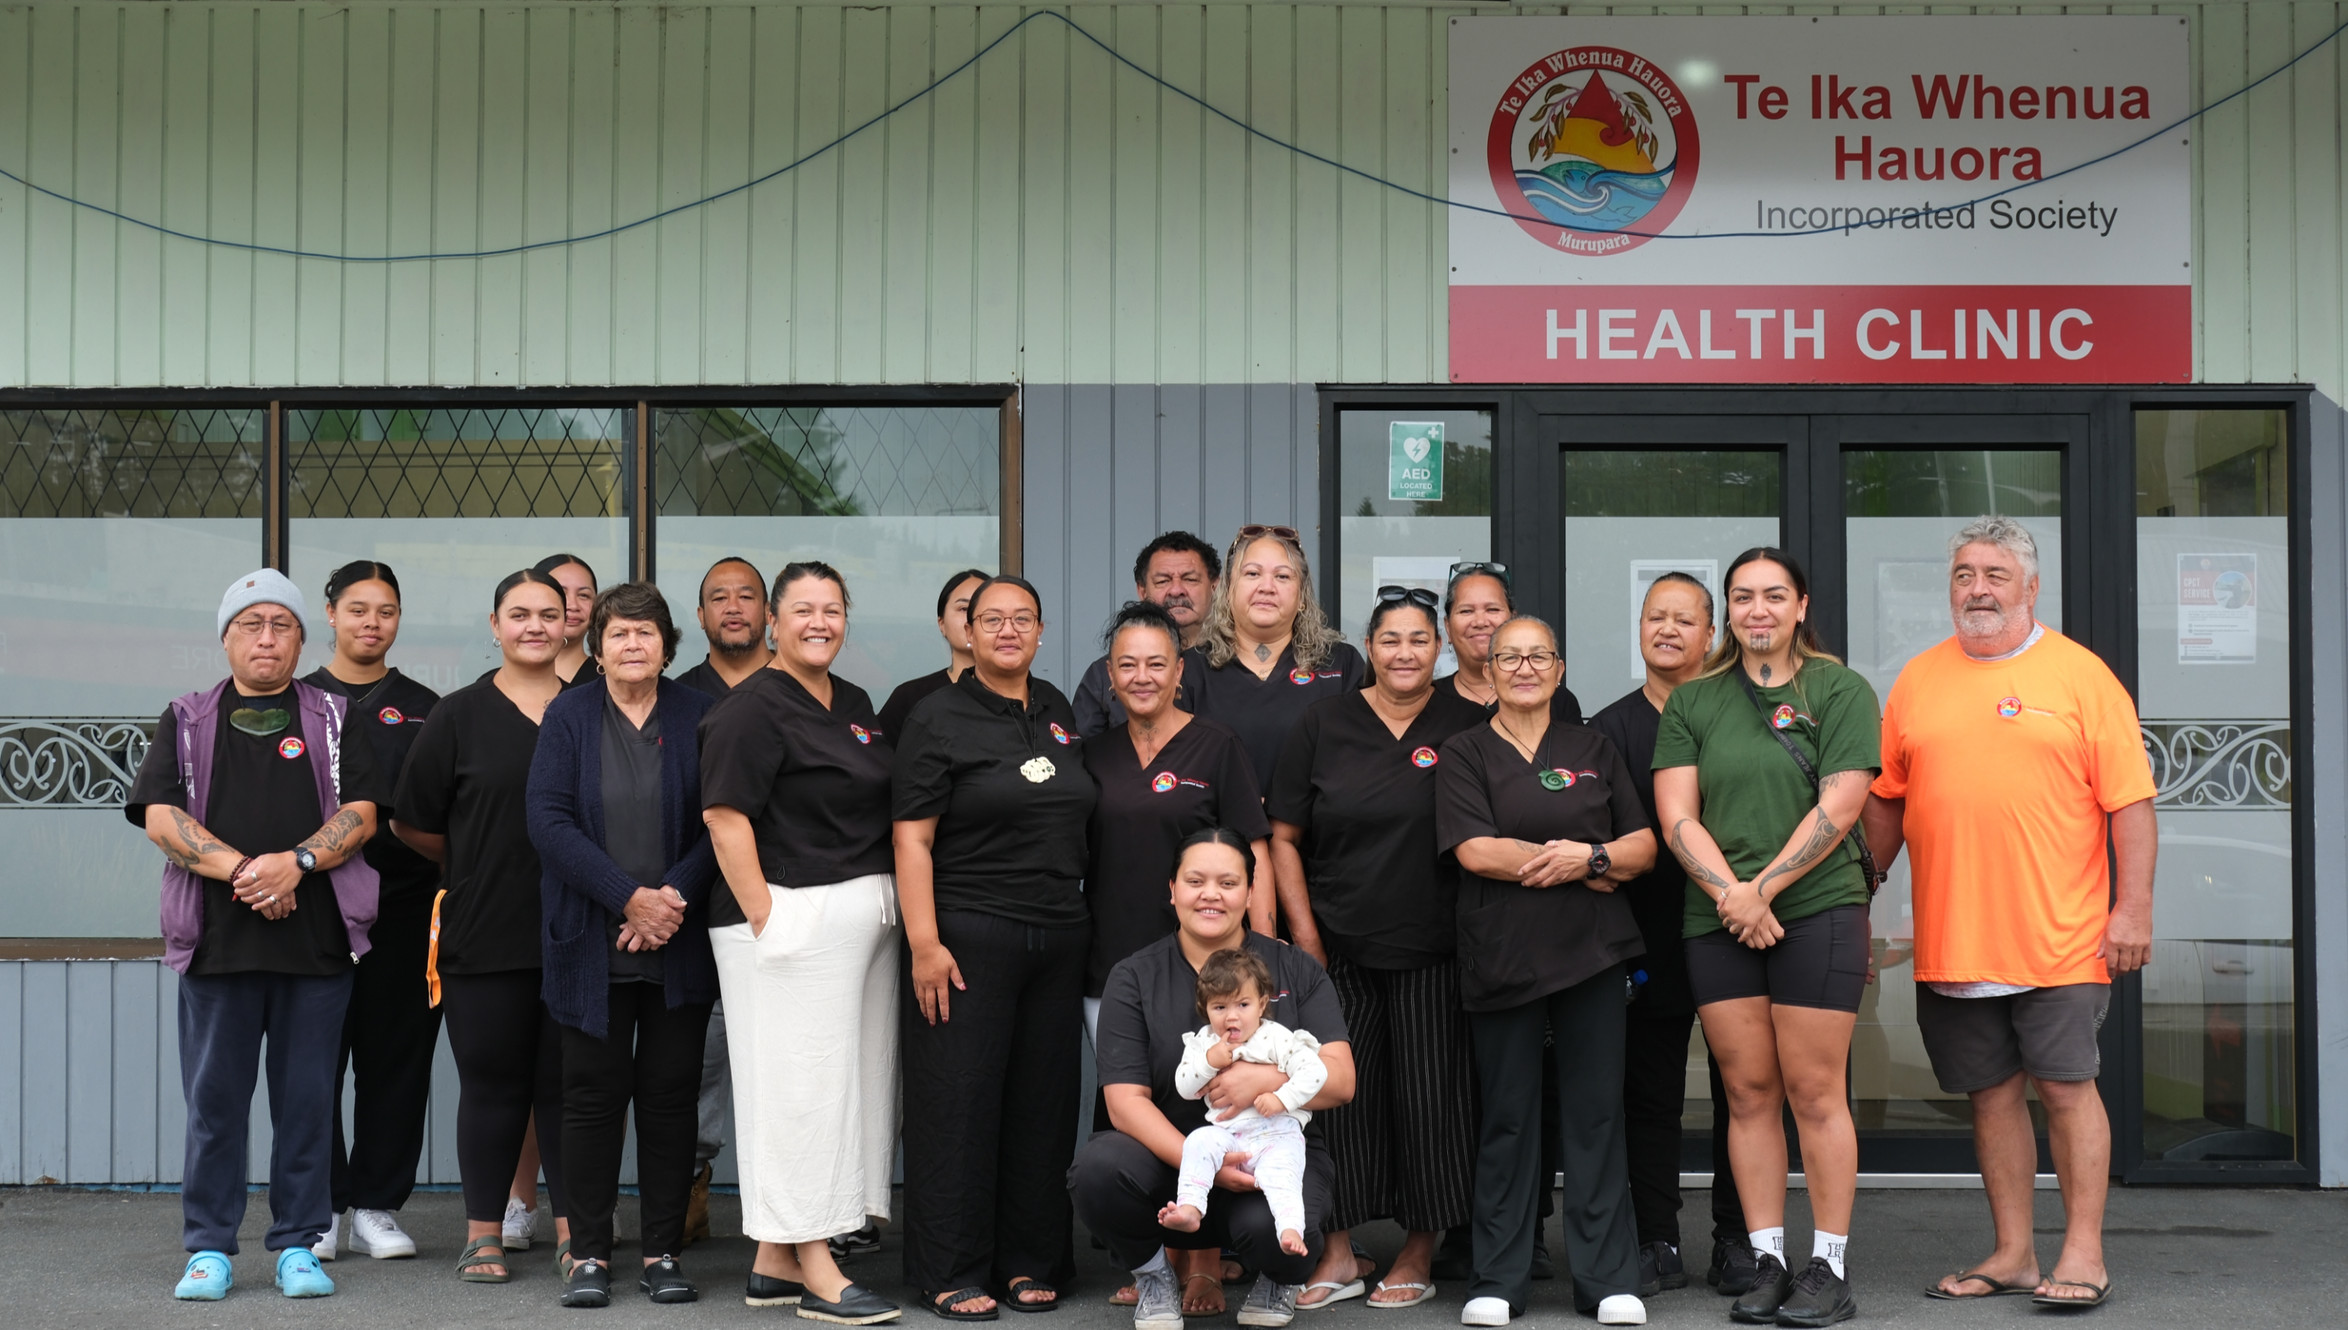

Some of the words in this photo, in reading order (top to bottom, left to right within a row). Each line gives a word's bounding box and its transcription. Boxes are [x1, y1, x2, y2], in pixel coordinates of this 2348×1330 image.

[1499, 93, 1522, 116] Te
[1520, 69, 1547, 97] Ika
[1545, 50, 1625, 74] Whenua
[1627, 57, 1683, 118] Hauora
[1724, 74, 1789, 121] Te
[1811, 74, 1892, 120] Ika
[1911, 74, 2152, 121] Whenua
[1835, 136, 2044, 182] Hauora
[1757, 199, 1976, 237] Incorporated
[1988, 199, 2118, 237] Society
[1557, 231, 1631, 255] Murupara
[1545, 308, 1826, 360] HEALTH
[1855, 307, 2095, 361] CLINIC
[1400, 482, 1433, 490] LOCATED
[1402, 468, 1431, 480] AED
[2183, 588, 2211, 599] SERVICE
